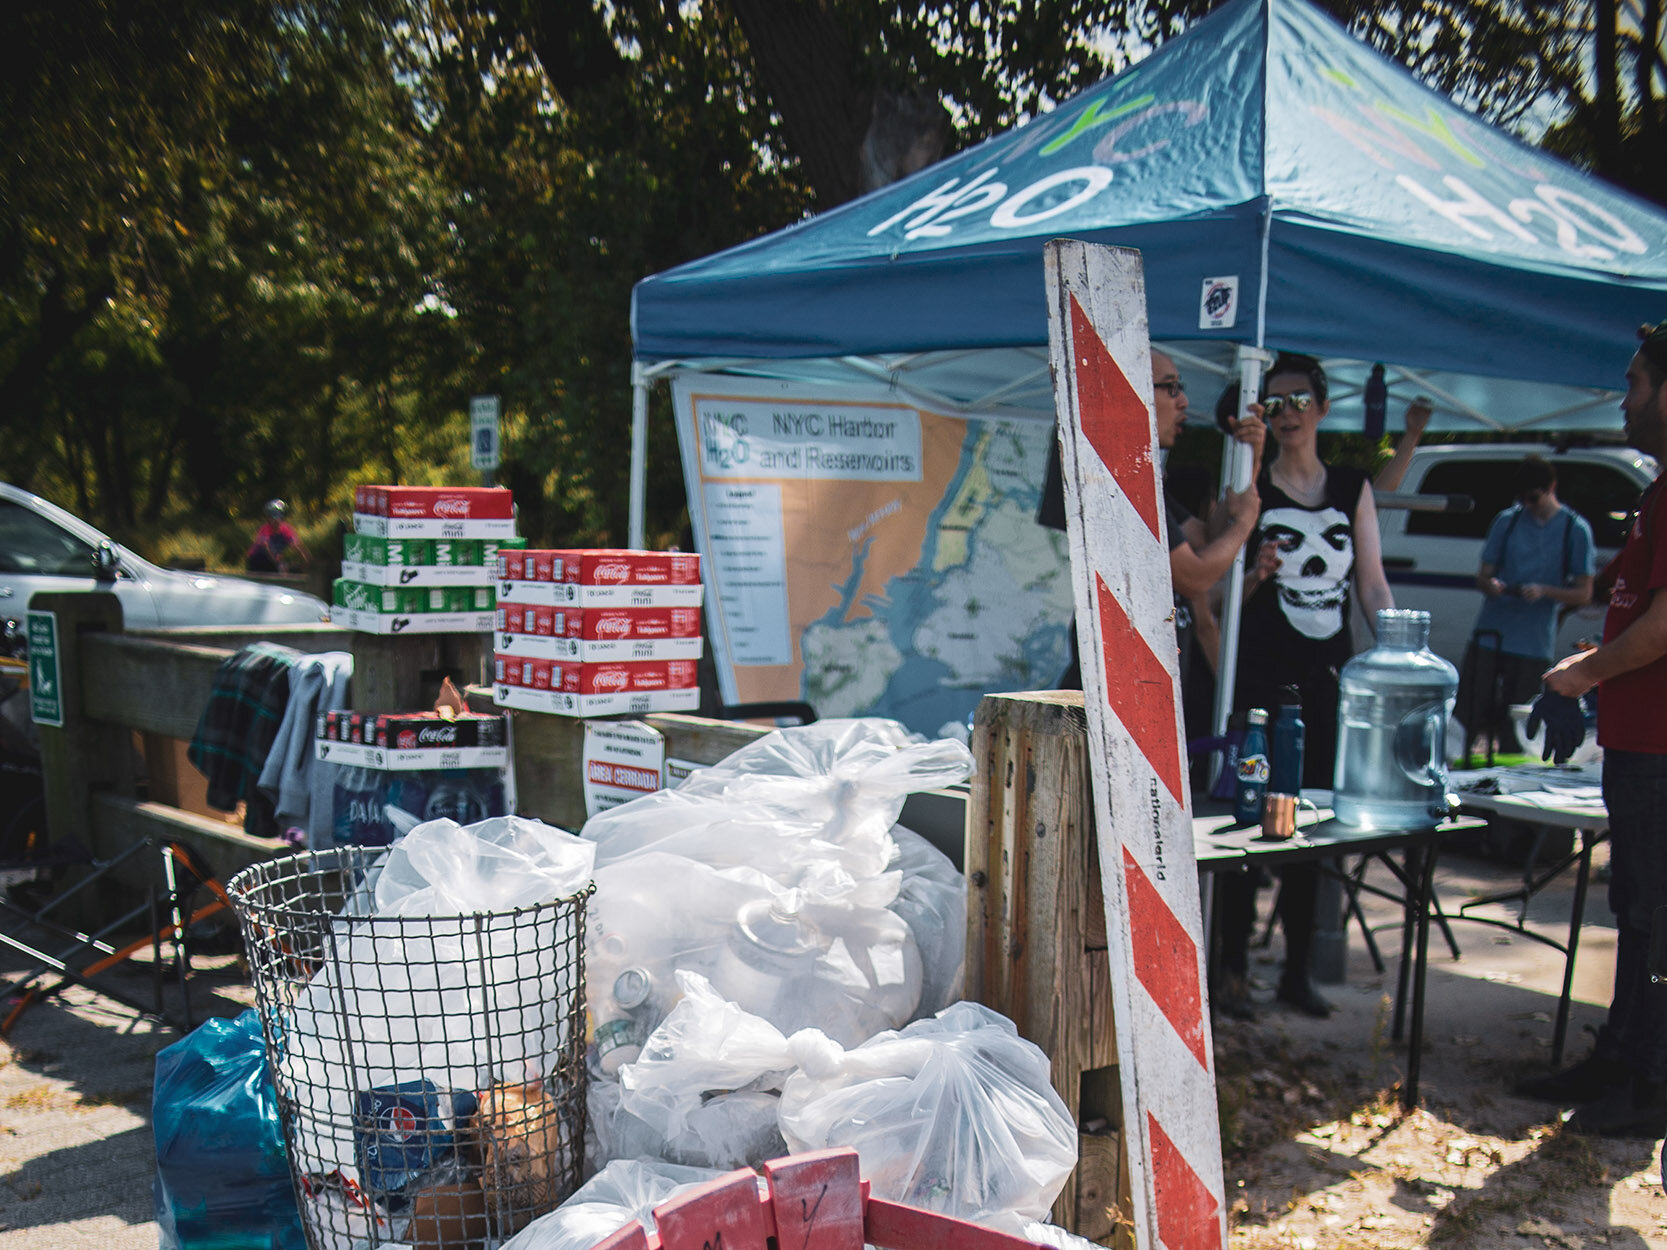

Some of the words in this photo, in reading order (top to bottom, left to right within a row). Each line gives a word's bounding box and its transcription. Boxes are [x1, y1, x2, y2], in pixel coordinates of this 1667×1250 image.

[1395, 173, 1649, 260] H2O
[772, 413, 824, 437] NYC
[828, 414, 898, 440] Harbor
[760, 450, 801, 471] and
[804, 447, 916, 474] Reservoirs
[418, 725, 458, 744] Coca-Cola
